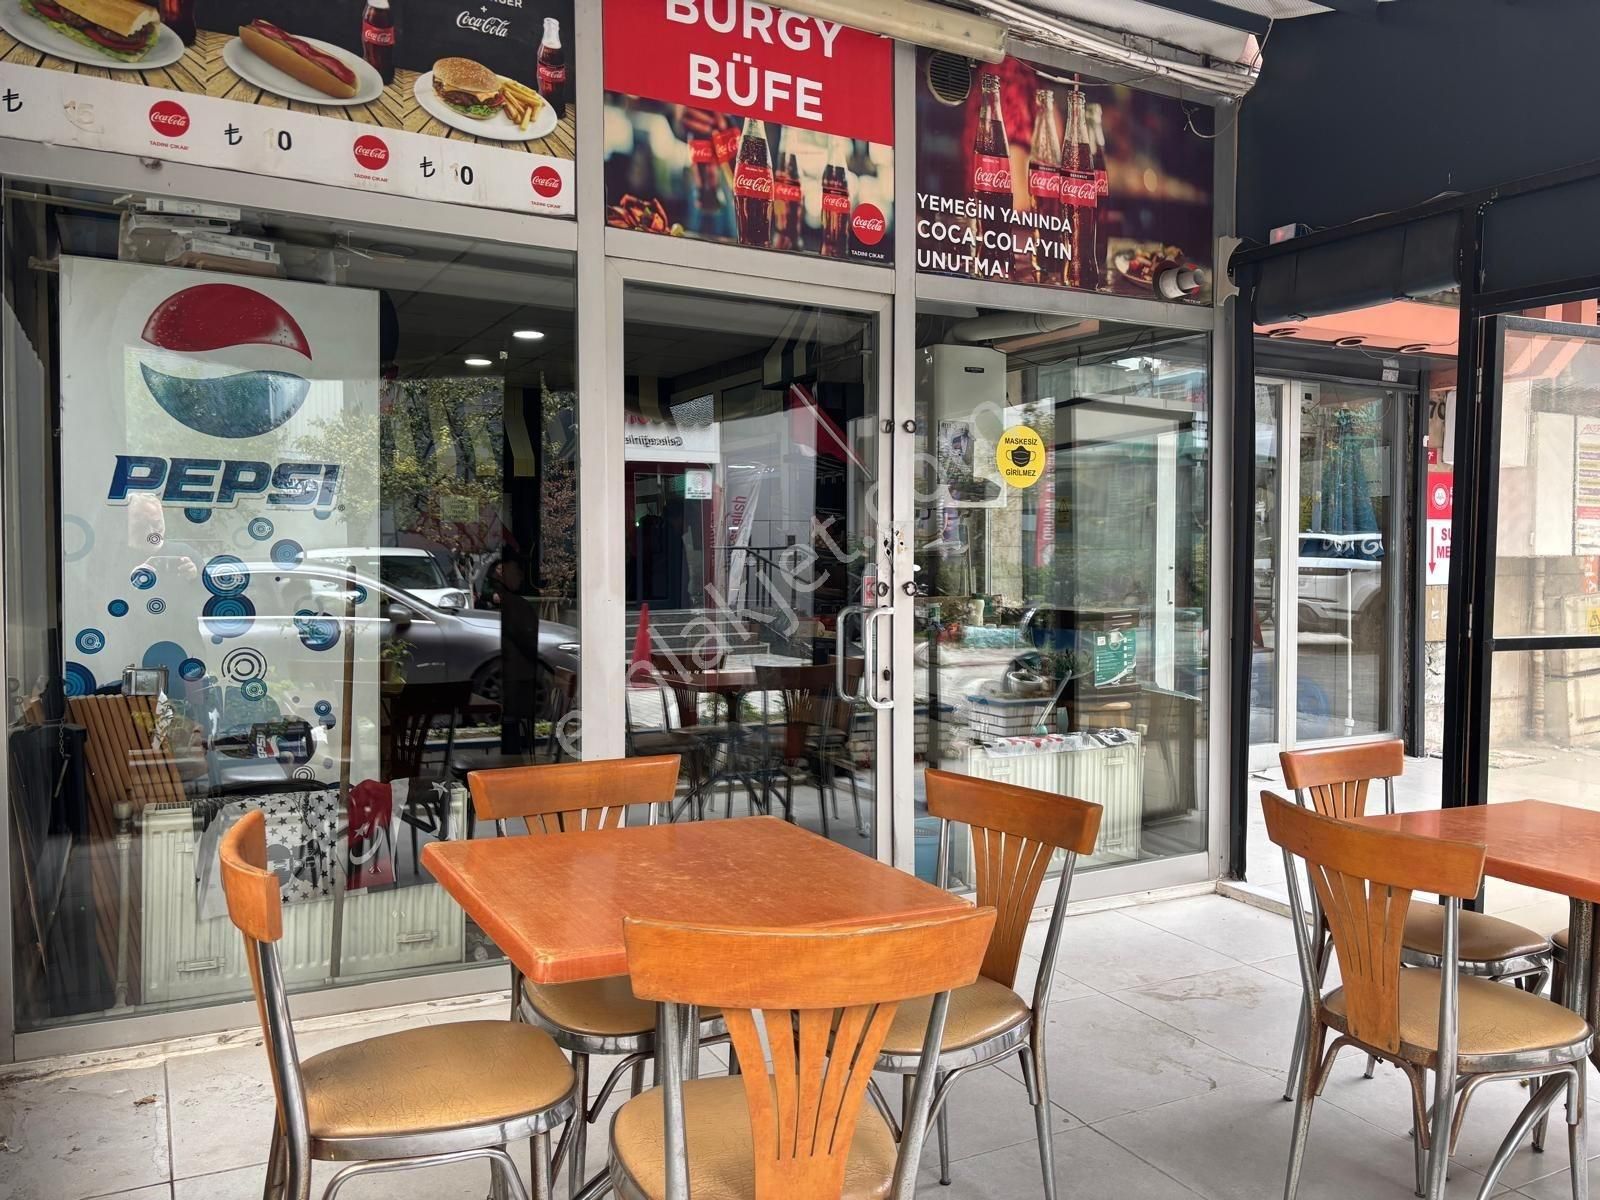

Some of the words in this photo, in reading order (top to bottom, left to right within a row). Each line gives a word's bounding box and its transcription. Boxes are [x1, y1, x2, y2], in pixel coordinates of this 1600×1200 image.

[456, 11, 511, 37] Coca-Cola
[666, 0, 843, 58] BURGY
[689, 52, 823, 122] BÜFE
[150, 111, 188, 127] Coca-Cola
[355, 145, 387, 160] Coca-Cola
[736, 174, 771, 193] Coca-Cola
[1061, 180, 1096, 200] Coca-Cola
[852, 216, 882, 232] Coca-Cola
[917, 192, 995, 220] YEMEĞİN
[1000, 207, 1073, 234] YANINDA
[917, 220, 1072, 261] COCA-COLA'YIN
[917, 249, 1010, 278] UNUTMA!
[1004, 437, 1038, 446] MASKESİZ
[106, 455, 341, 511] PEPSI
[1005, 468, 1037, 477] GİRİLMEZ
